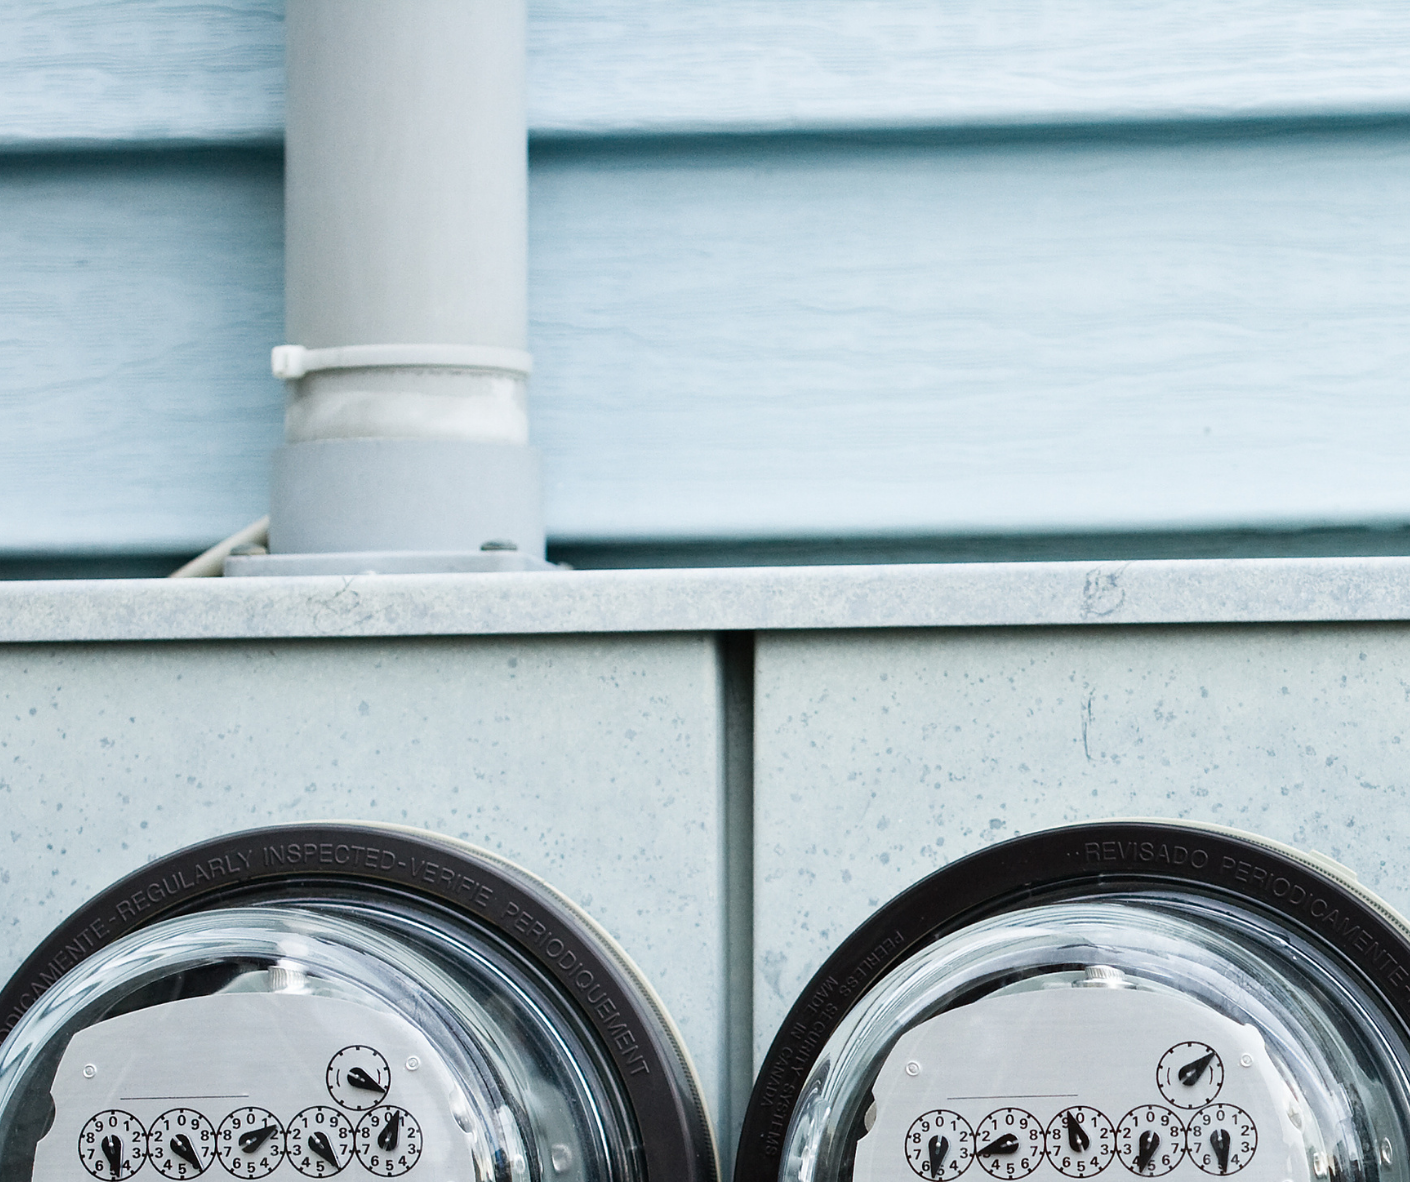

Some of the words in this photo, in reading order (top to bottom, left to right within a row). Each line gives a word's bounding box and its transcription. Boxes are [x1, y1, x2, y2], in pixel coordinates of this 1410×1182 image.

[1083, 840, 1209, 870] REVISADO
[501, 901, 651, 1077] PERIODIQUEMENT
[839, 929, 905, 999] PEERLESS
[804, 975, 840, 1019] MADE
[789, 1004, 839, 1078] SECURITY
[790, 1023, 808, 1041] IN
[760, 1047, 794, 1109] CANADA
